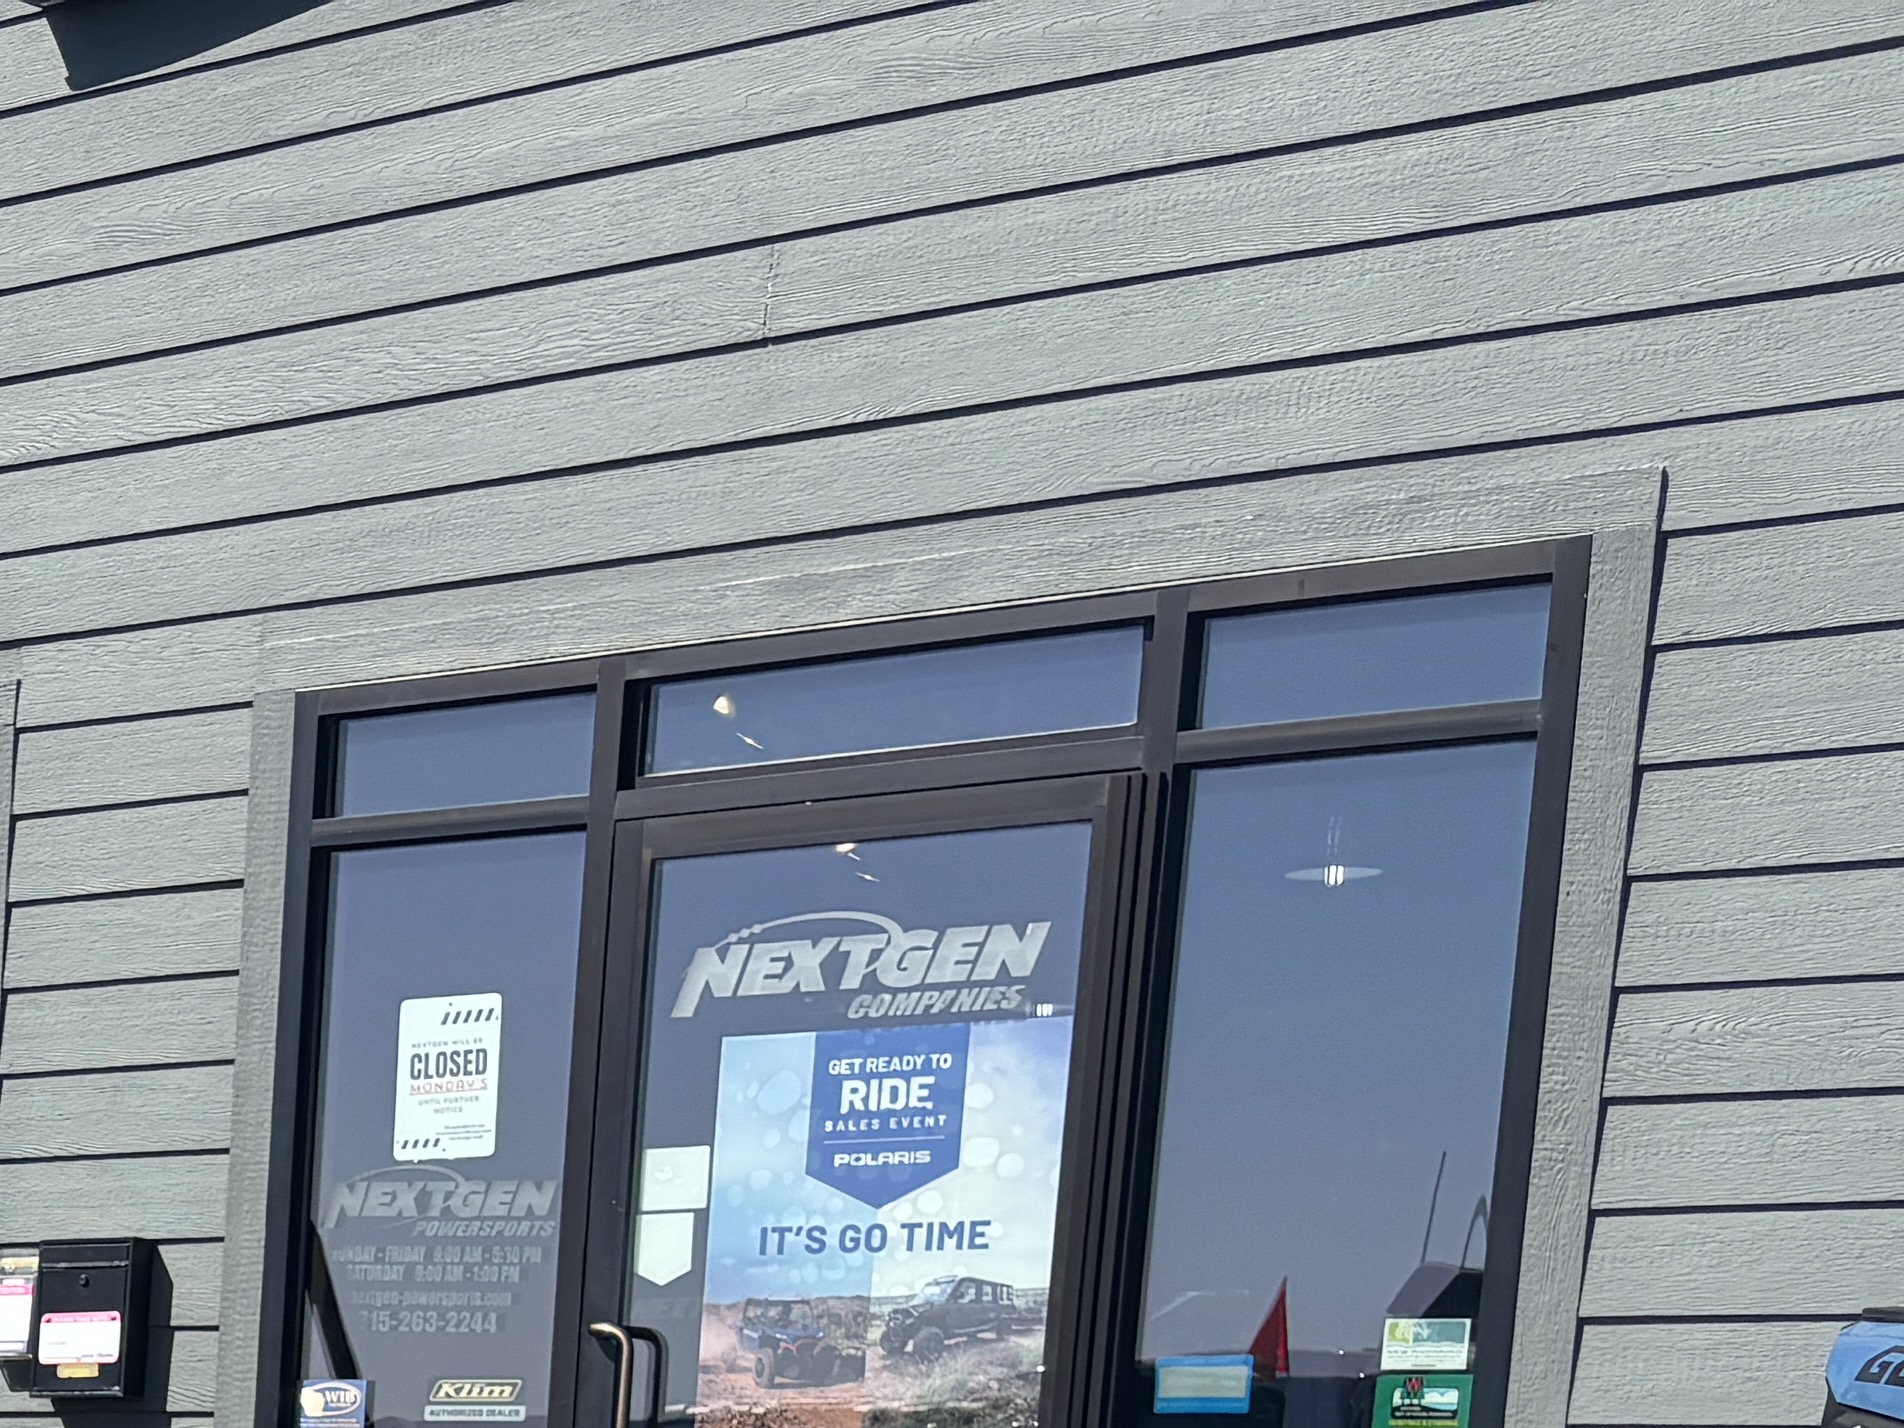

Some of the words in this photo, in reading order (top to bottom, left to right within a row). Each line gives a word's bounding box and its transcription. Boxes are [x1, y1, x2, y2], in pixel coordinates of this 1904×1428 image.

[670, 921, 1052, 1018] NEXTGEN
[847, 984, 1026, 1020] COMPANIES
[410, 1048, 488, 1081] CLOSED
[828, 1057, 861, 1076] GET
[866, 1055, 924, 1073] READY
[929, 1052, 953, 1070] TO
[840, 1075, 936, 1114] RIDE
[824, 1119, 881, 1133] SALES
[890, 1114, 947, 1130] EVENT
[833, 1149, 931, 1168] POLARIS
[321, 1179, 558, 1229] NEXTGEN
[412, 1221, 557, 1237] POWERSPORTS
[838, 1221, 888, 1254] GO
[900, 1220, 992, 1252] TIME
[385, 1246, 426, 1262] FRIDAY
[463, 1246, 483, 1263] AM
[522, 1247, 542, 1264] PM
[346, 1264, 406, 1281] SATURDAY
[444, 1265, 464, 1282] AM
[501, 1266, 520, 1283] PM
[429, 1408, 484, 1418] AUTHORIZED
[485, 1408, 520, 1418] DEALER
